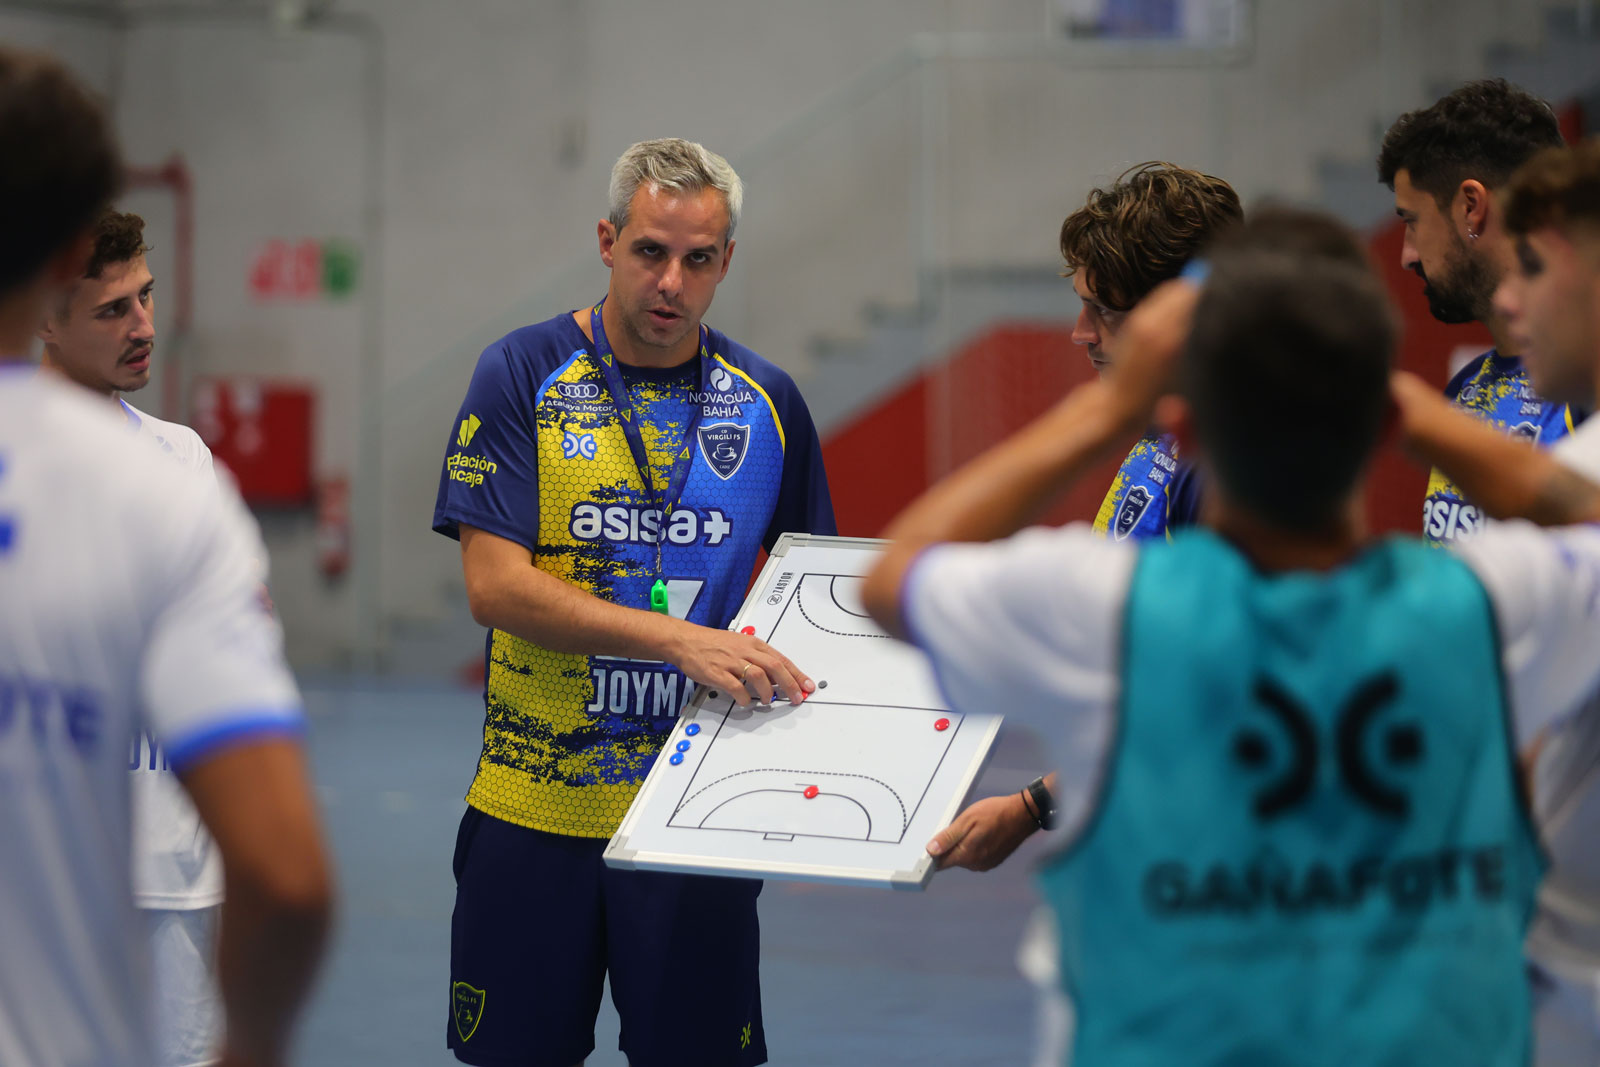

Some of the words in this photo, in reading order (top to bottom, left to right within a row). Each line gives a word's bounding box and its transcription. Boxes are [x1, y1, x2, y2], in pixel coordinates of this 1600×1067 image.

[689, 391, 753, 404] NOVAQUA
[546, 400, 580, 411] Atalaya
[703, 405, 741, 417] BAHIA
[773, 572, 793, 594] ZASTOR
